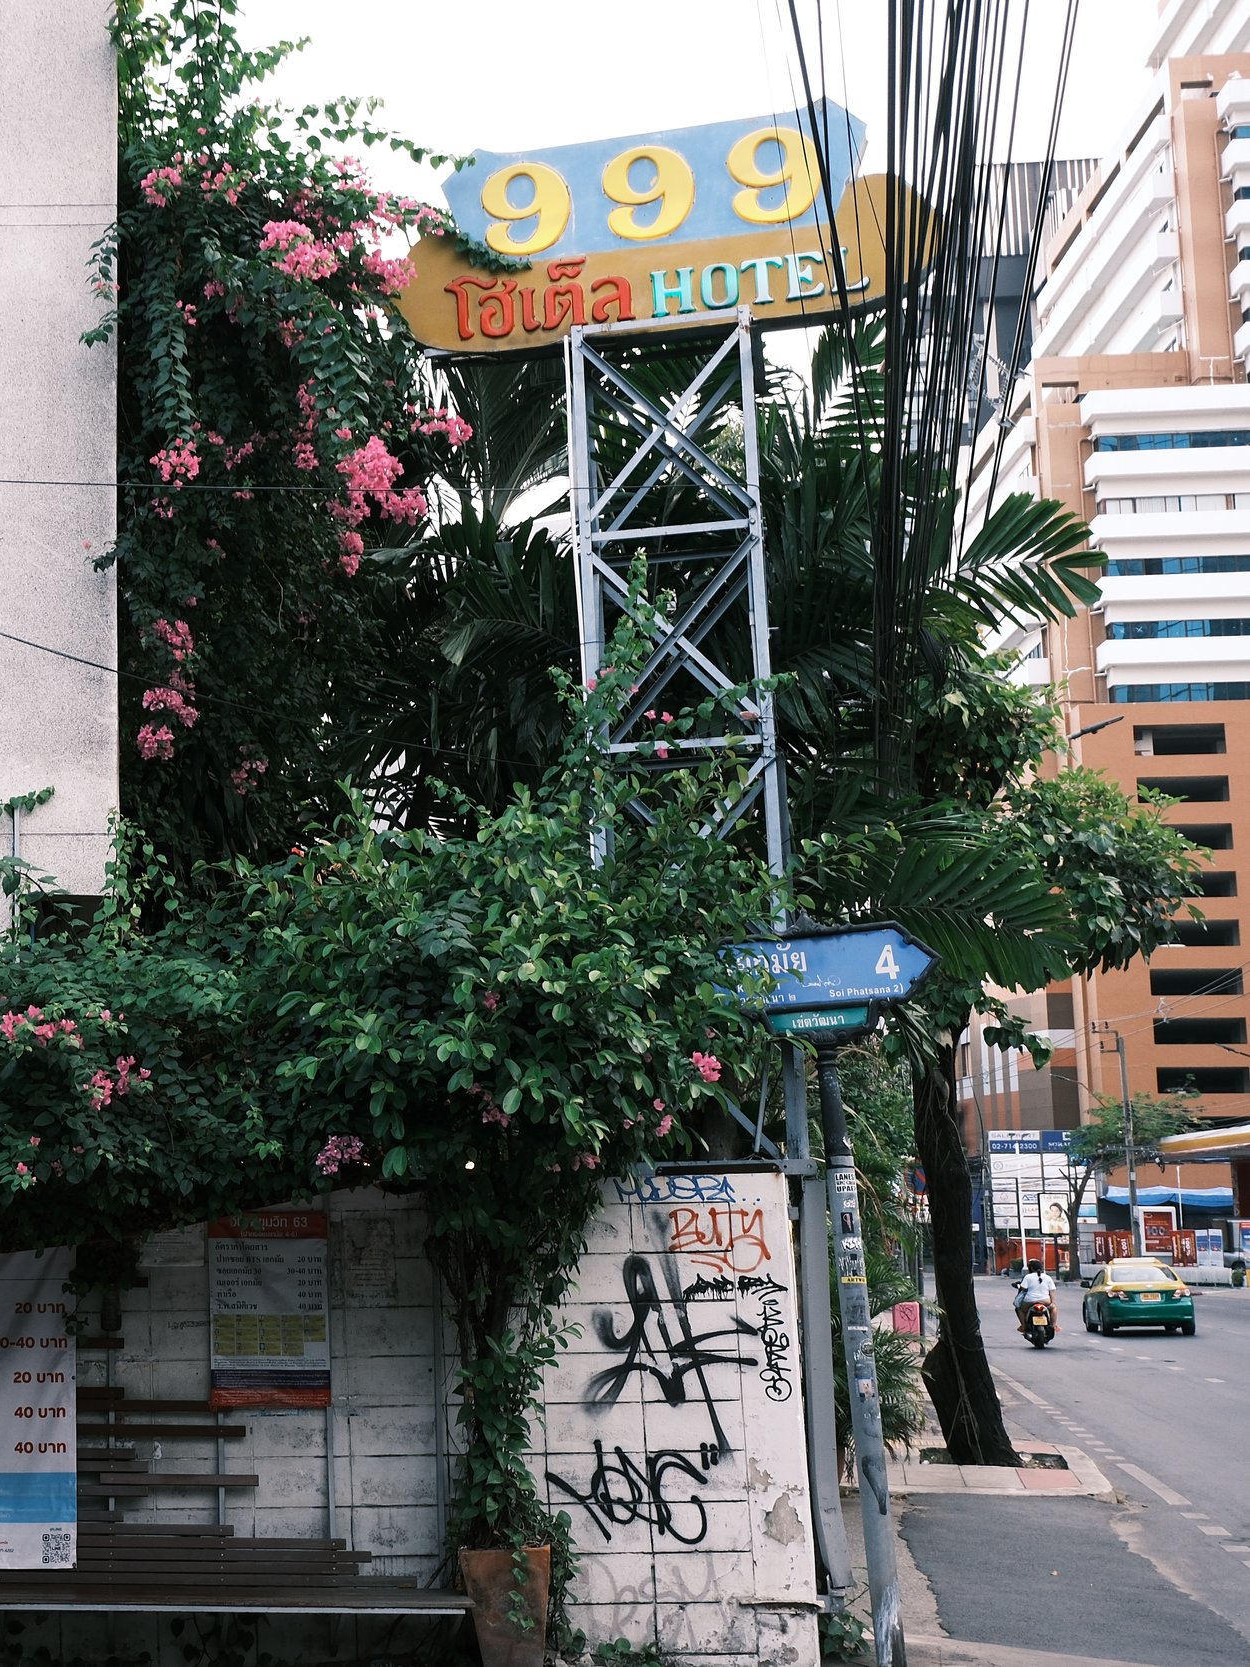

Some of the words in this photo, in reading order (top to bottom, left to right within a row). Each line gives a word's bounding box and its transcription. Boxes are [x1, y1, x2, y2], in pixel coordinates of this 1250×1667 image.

[445, 256, 636, 341] โฮเต็ล
[650, 246, 872, 318] HOTEL
[875, 944, 900, 980] 4
[829, 988, 845, 998] Soi
[847, 985, 891, 997] Phatsana
[792, 1014, 845, 1029] เขตวัฒนา
[293, 1216, 308, 1228] 63
[297, 1279, 306, 1287] 20
[15, 1303, 35, 1315] 20
[38, 1302, 67, 1315] บาท
[40, 1337, 68, 1349] บาท
[13, 1372, 34, 1383] 20
[37, 1371, 65, 1383] บาท
[14, 1406, 34, 1418] 40
[38, 1406, 66, 1418] บาท
[14, 1441, 34, 1453] 40
[38, 1441, 67, 1453] บาท
